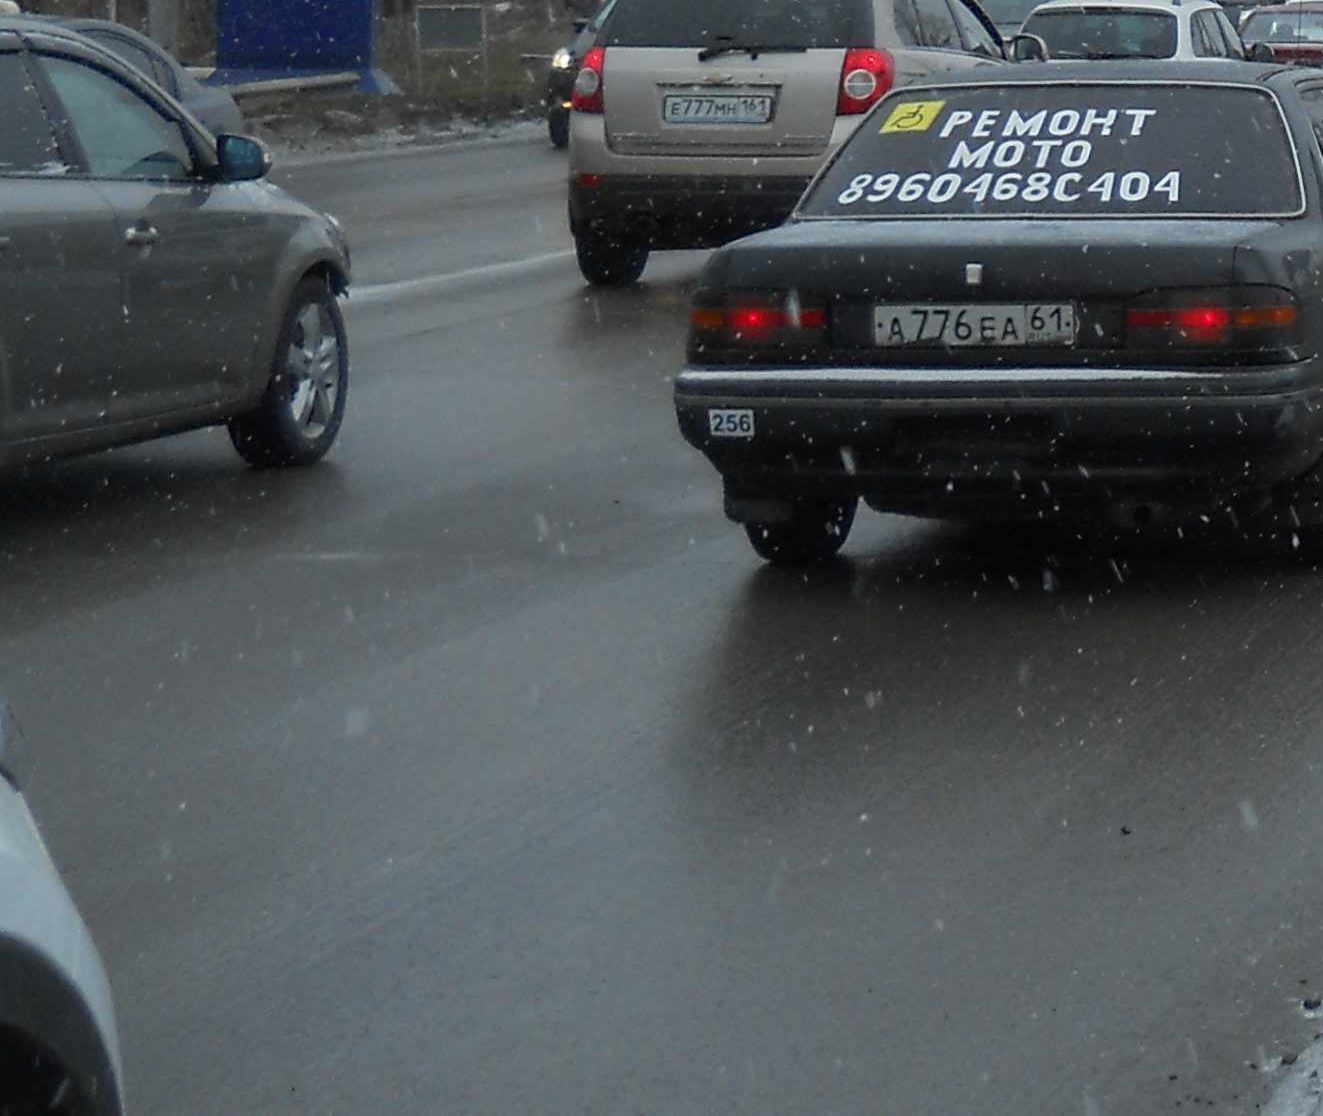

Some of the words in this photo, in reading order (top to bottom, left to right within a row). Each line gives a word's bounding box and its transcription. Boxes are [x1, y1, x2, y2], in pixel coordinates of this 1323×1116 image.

[671, 99, 736, 116] Е777МН
[742, 99, 767, 113] 161
[939, 109, 1156, 138] РЕМОНТ
[948, 140, 1092, 169] МОТО
[888, 309, 1018, 341] А776ЕА
[1031, 306, 1062, 331] 61
[711, 414, 751, 432] 256
